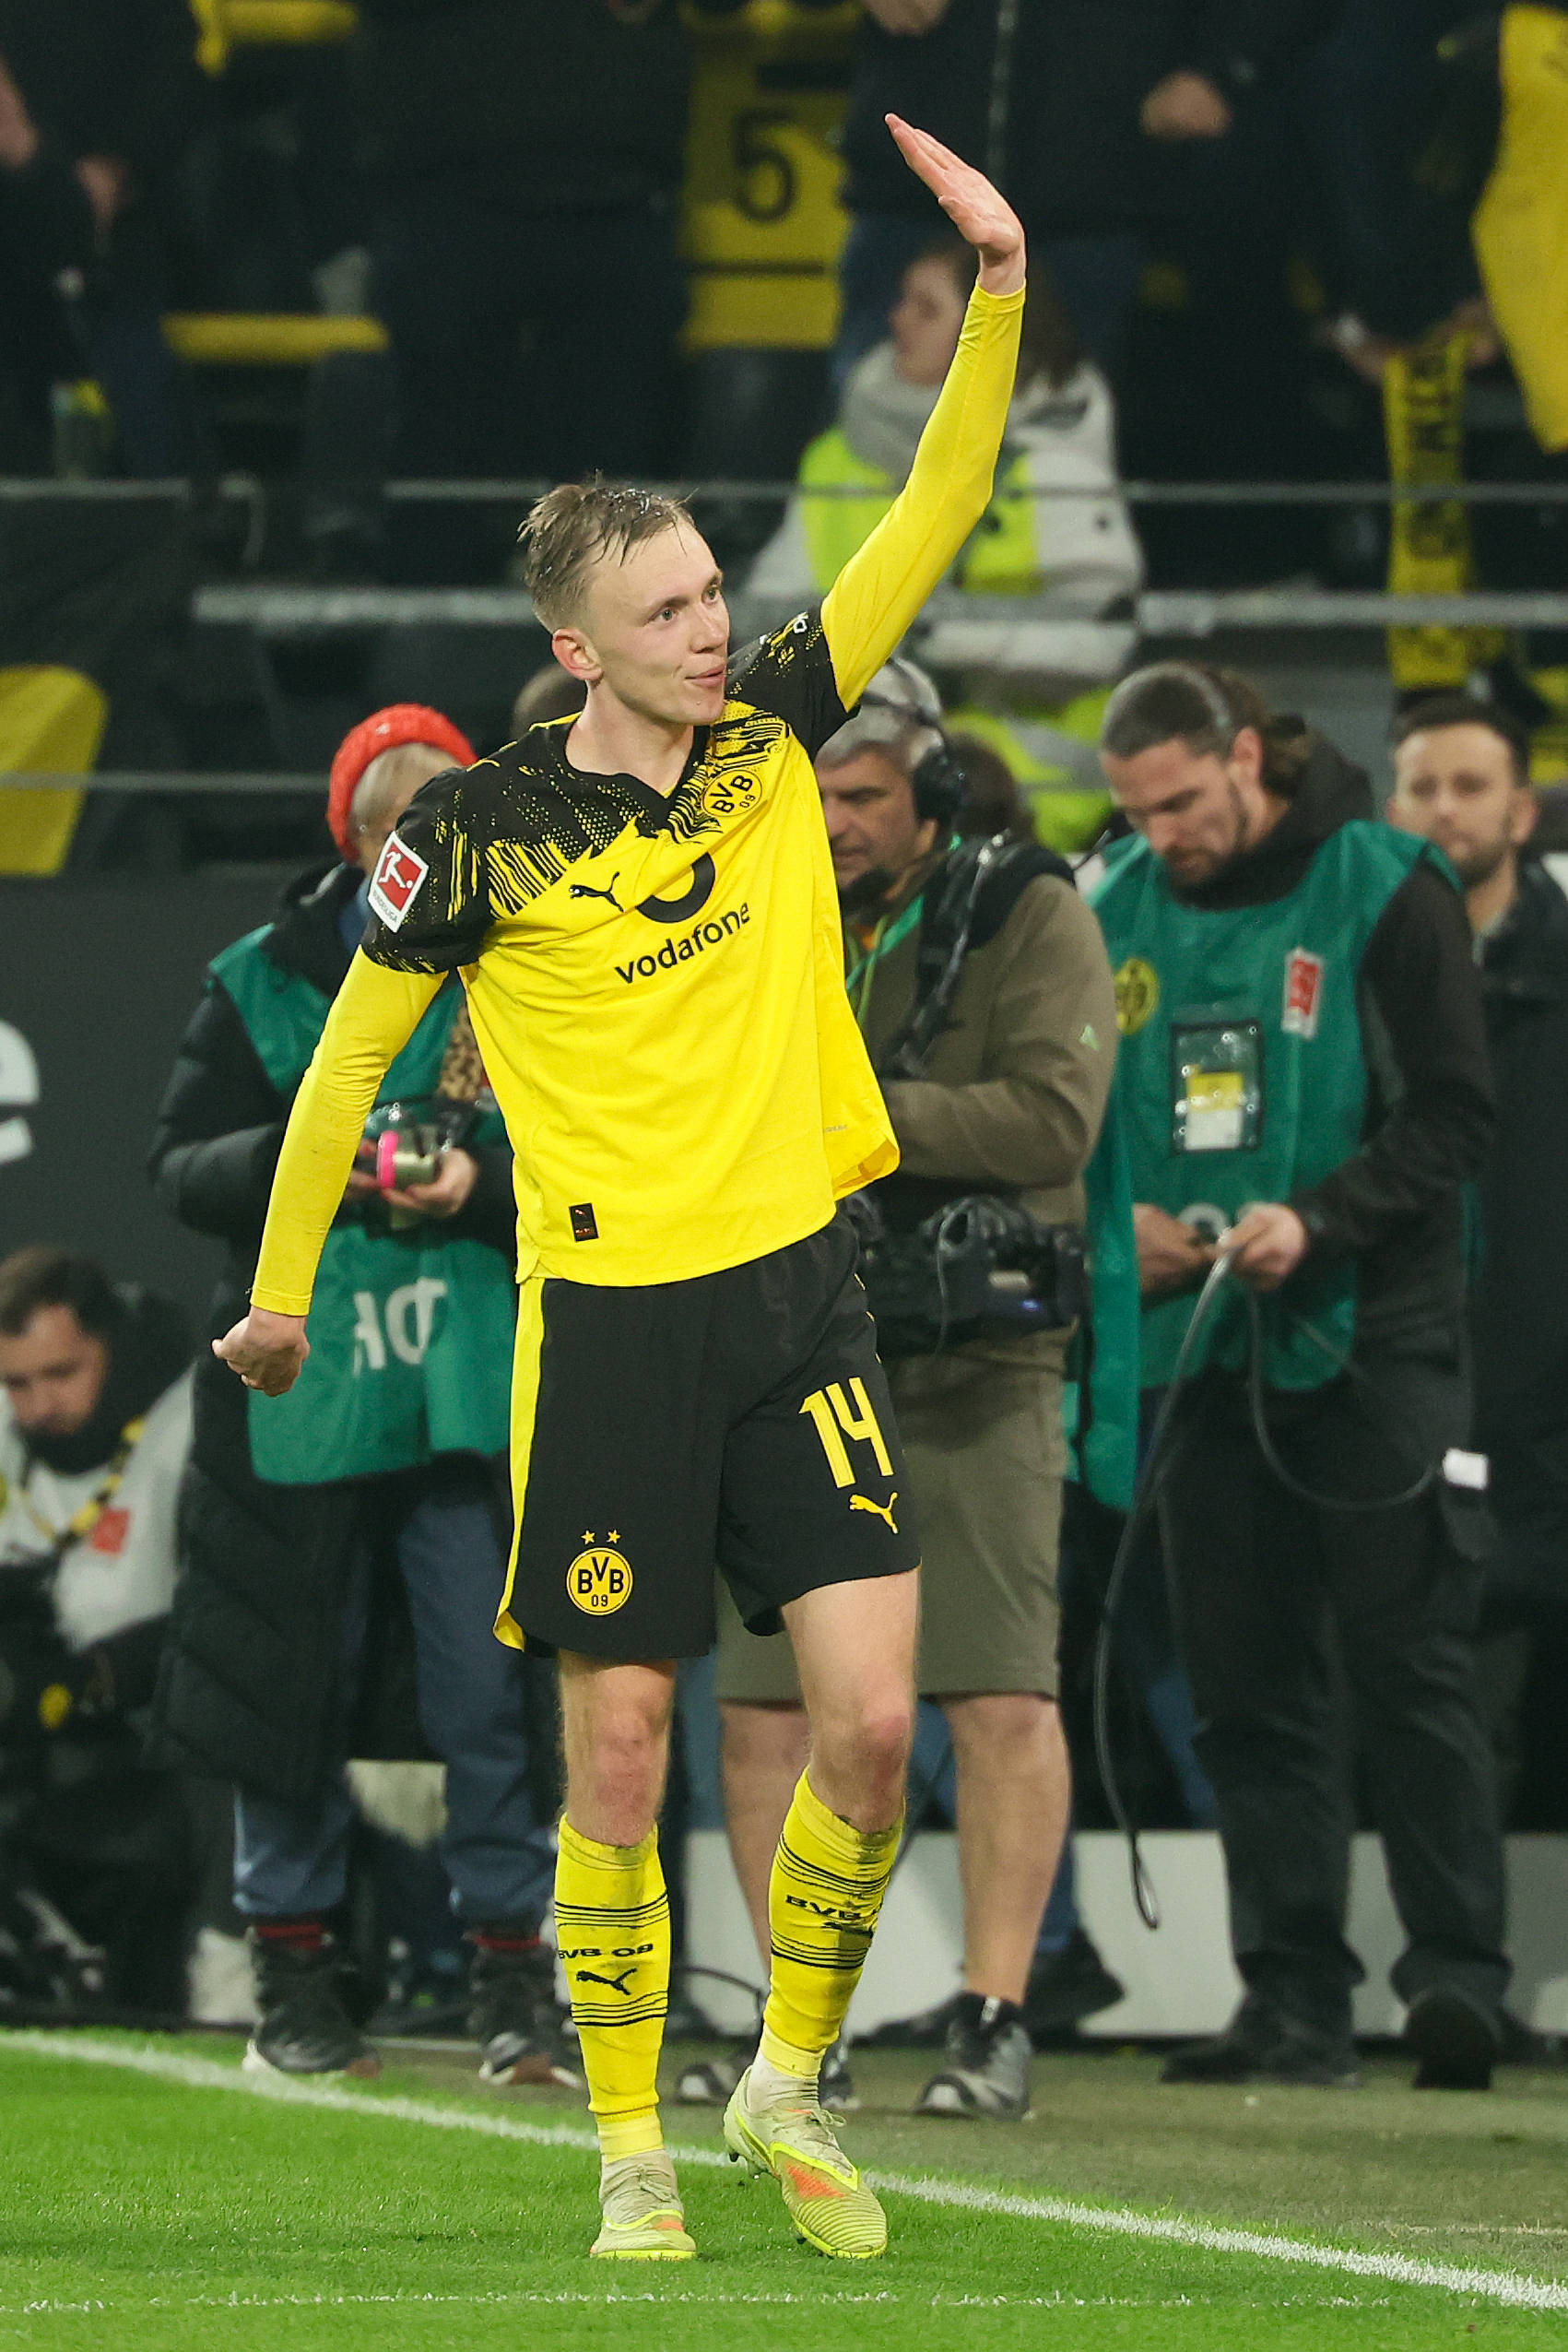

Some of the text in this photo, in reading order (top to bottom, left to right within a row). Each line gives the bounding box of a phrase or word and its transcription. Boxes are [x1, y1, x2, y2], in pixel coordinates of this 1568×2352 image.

[710, 775, 754, 813] BVB
[739, 794, 756, 808] 09
[614, 902, 750, 984] vodafone
[798, 1377, 895, 1488] 14
[578, 1556, 624, 1594] BVB
[591, 1594, 608, 1607] 09
[785, 1895, 862, 1921] BVB
[558, 1948, 602, 1959] BVB
